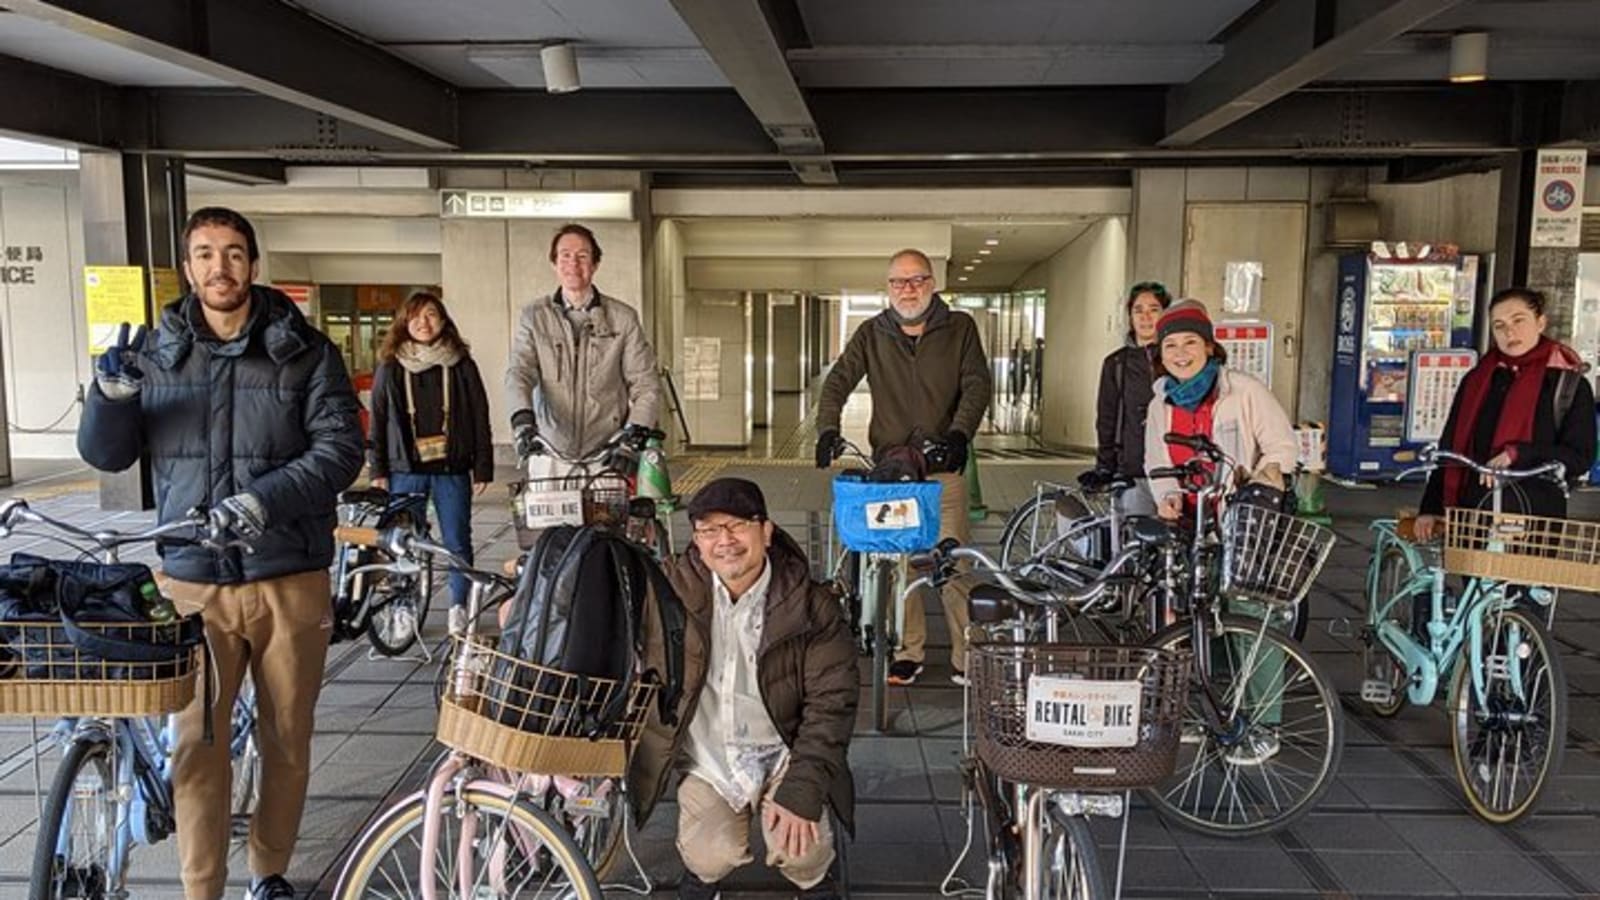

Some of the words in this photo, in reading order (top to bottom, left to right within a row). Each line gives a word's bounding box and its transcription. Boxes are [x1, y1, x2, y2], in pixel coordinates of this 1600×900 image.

[0, 246, 43, 262] 便局
[1035, 700, 1087, 726] RENTAL
[1103, 704, 1133, 727] BIKE
[1086, 730, 1104, 738] CITY
